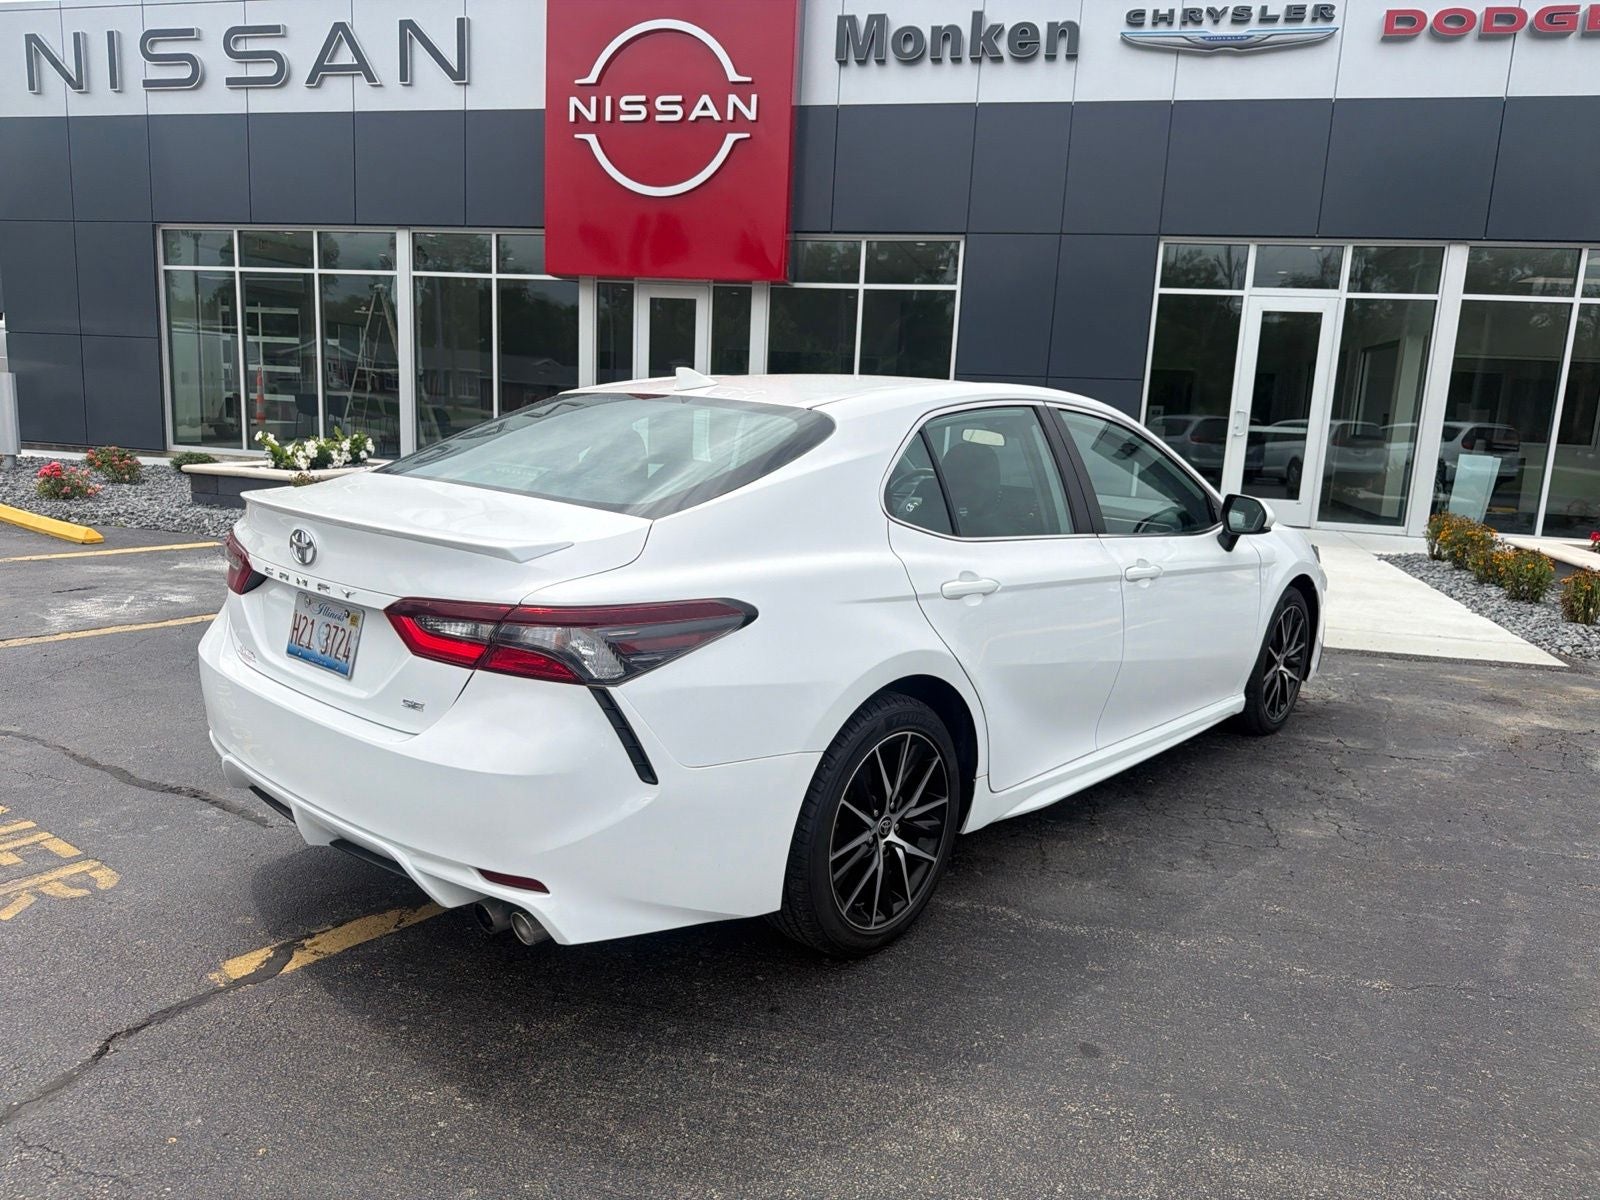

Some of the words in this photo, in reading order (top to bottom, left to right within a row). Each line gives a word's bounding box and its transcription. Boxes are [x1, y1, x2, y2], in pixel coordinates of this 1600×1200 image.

[1125, 3, 1336, 26] CHRYSLER
[24, 16, 470, 94] NISSAN
[835, 10, 1080, 64] Monken
[569, 94, 758, 122] NISSAN
[310, 602, 346, 622] Illinois
[290, 612, 315, 650] H21
[320, 622, 352, 663] 3724
